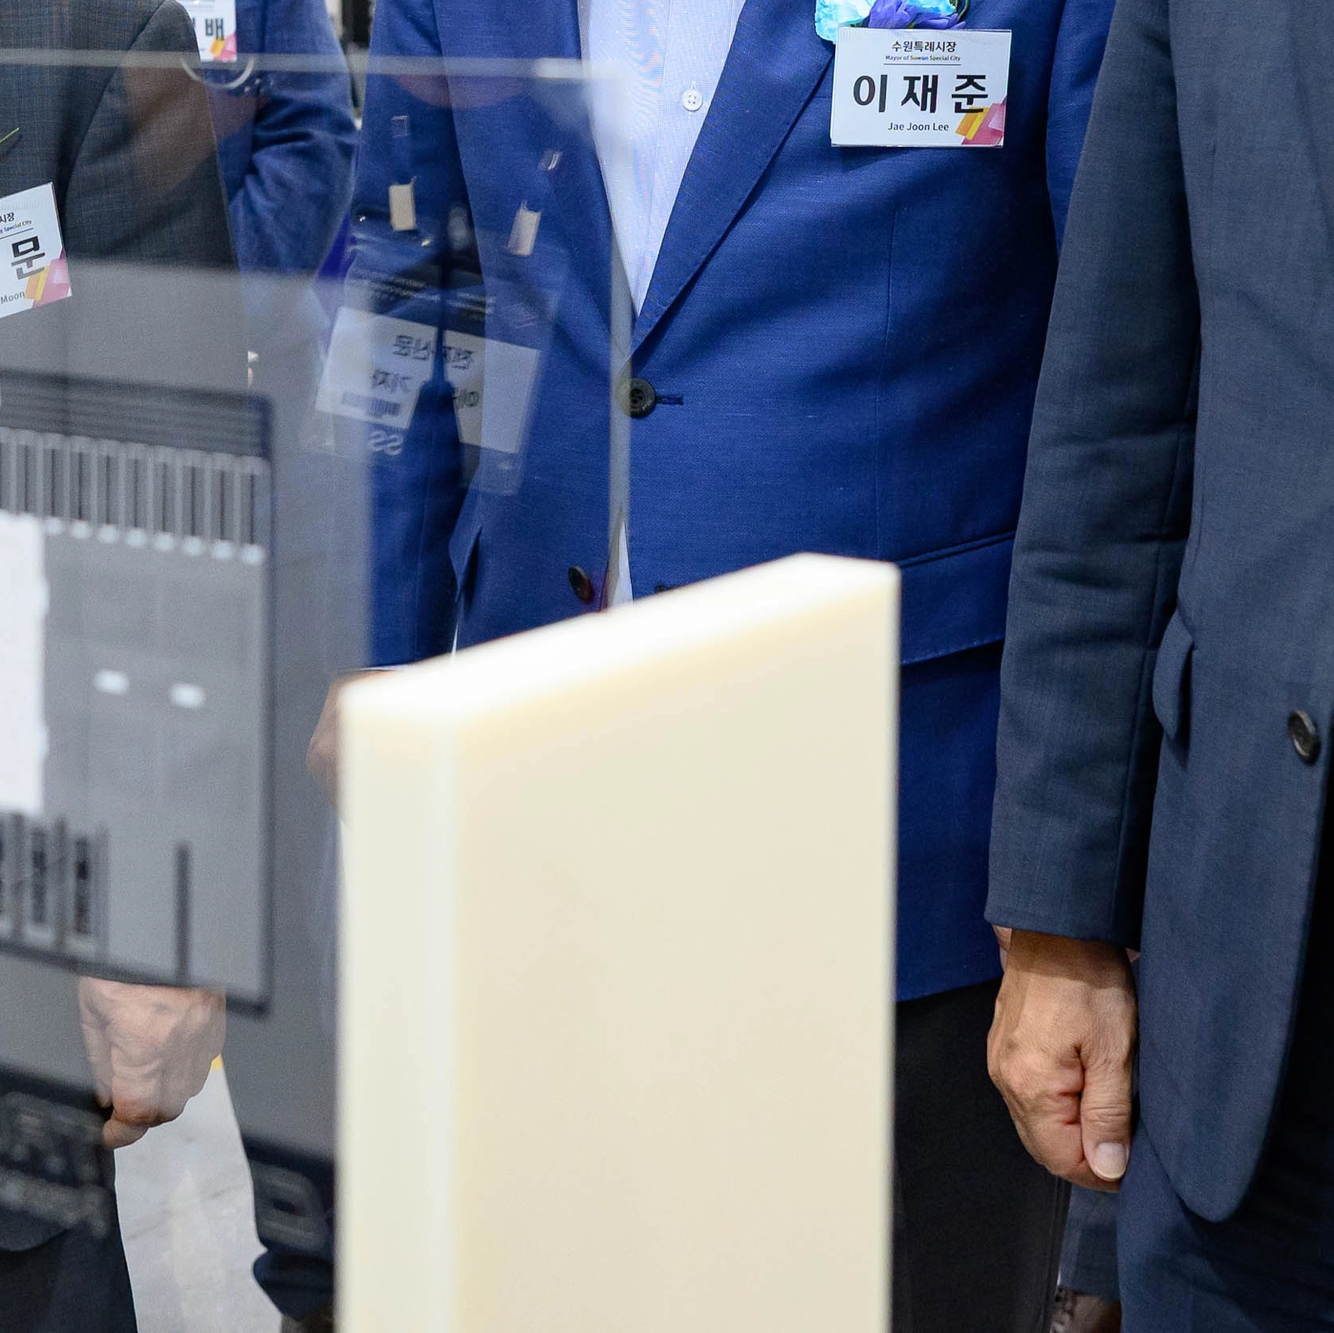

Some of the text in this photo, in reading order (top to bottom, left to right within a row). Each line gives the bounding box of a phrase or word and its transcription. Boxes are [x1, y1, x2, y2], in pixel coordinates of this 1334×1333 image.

[892, 40, 957, 53] 수원특례시장
[853, 74, 989, 114] 이재준
[888, 122, 949, 132] Jae Joon Lee
[3, 223, 21, 234] Special
[21, 219, 32, 229] City
[0, 291, 26, 305] Moon
